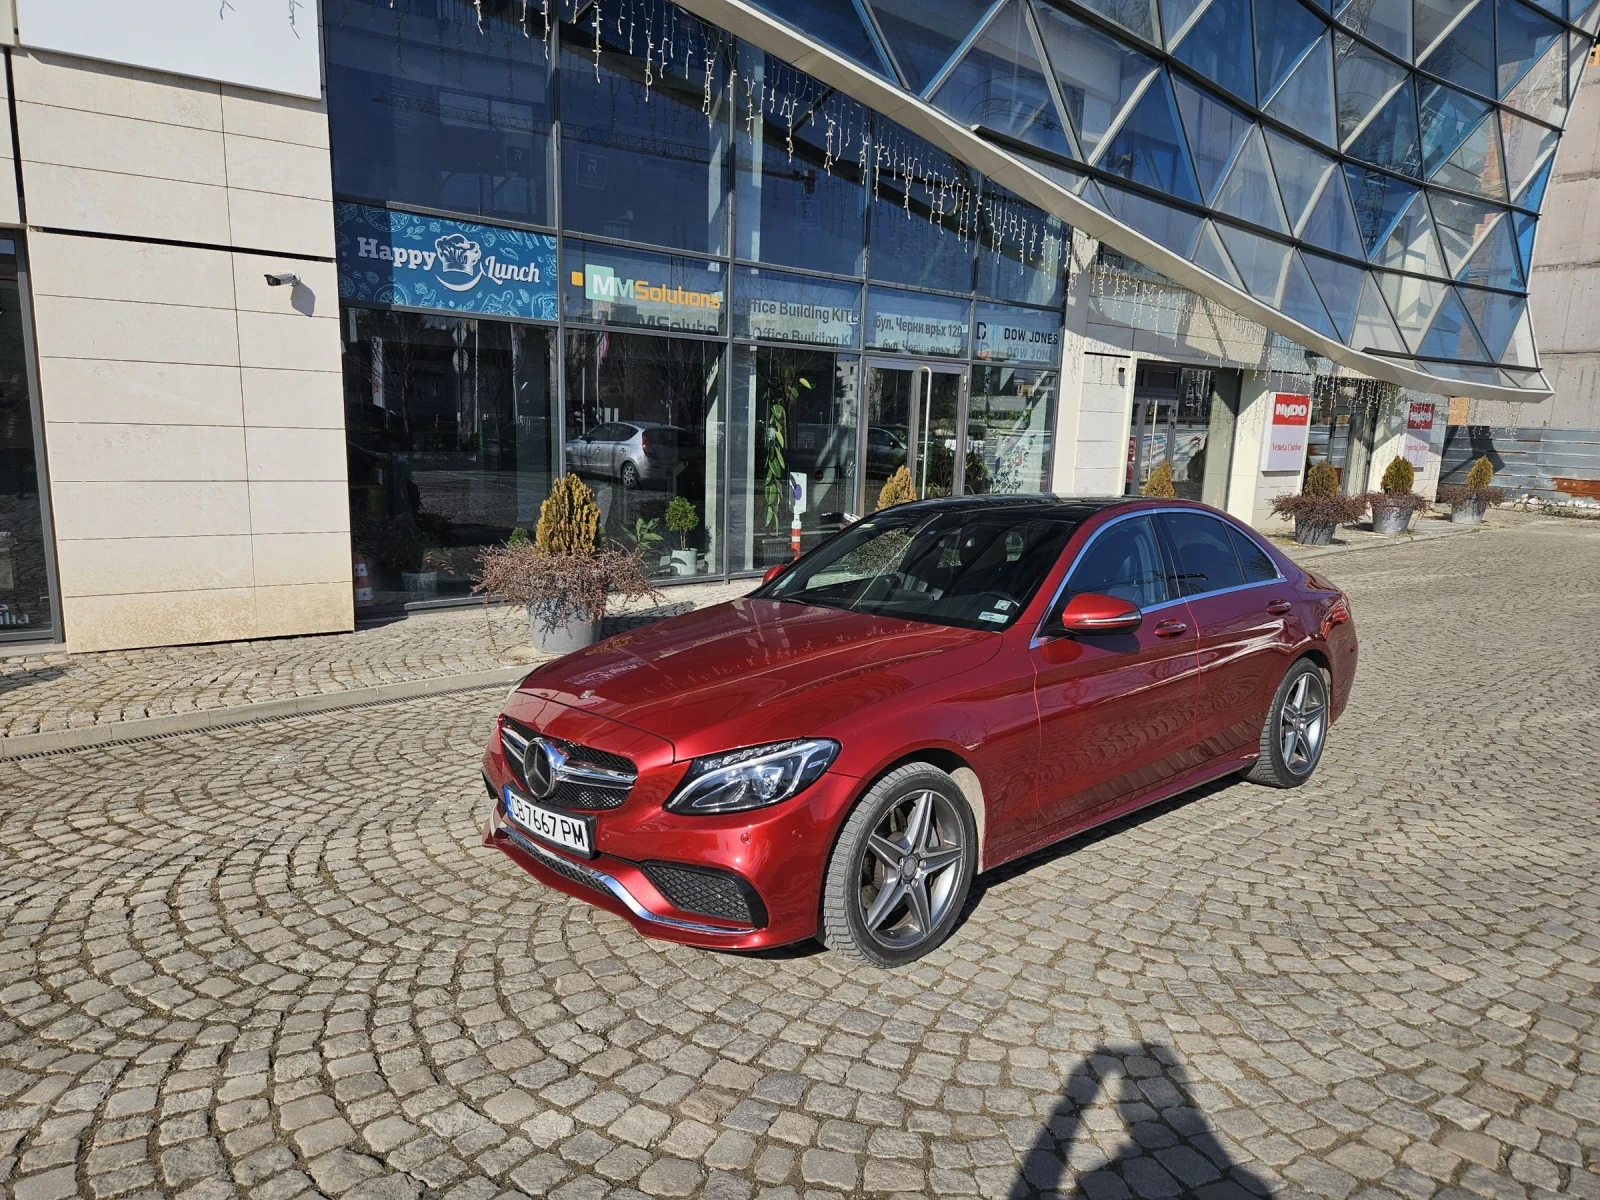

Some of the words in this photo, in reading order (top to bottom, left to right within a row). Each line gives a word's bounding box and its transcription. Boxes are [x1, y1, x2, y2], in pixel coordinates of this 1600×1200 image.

[357, 236, 437, 271] Happy
[484, 256, 541, 285] Lunch
[779, 301, 829, 323] Building
[875, 314, 894, 332] бул.
[896, 316, 924, 335] Черни
[925, 323, 947, 337] връх
[1004, 328, 1027, 342] DOW
[1029, 331, 1059, 345] JONES
